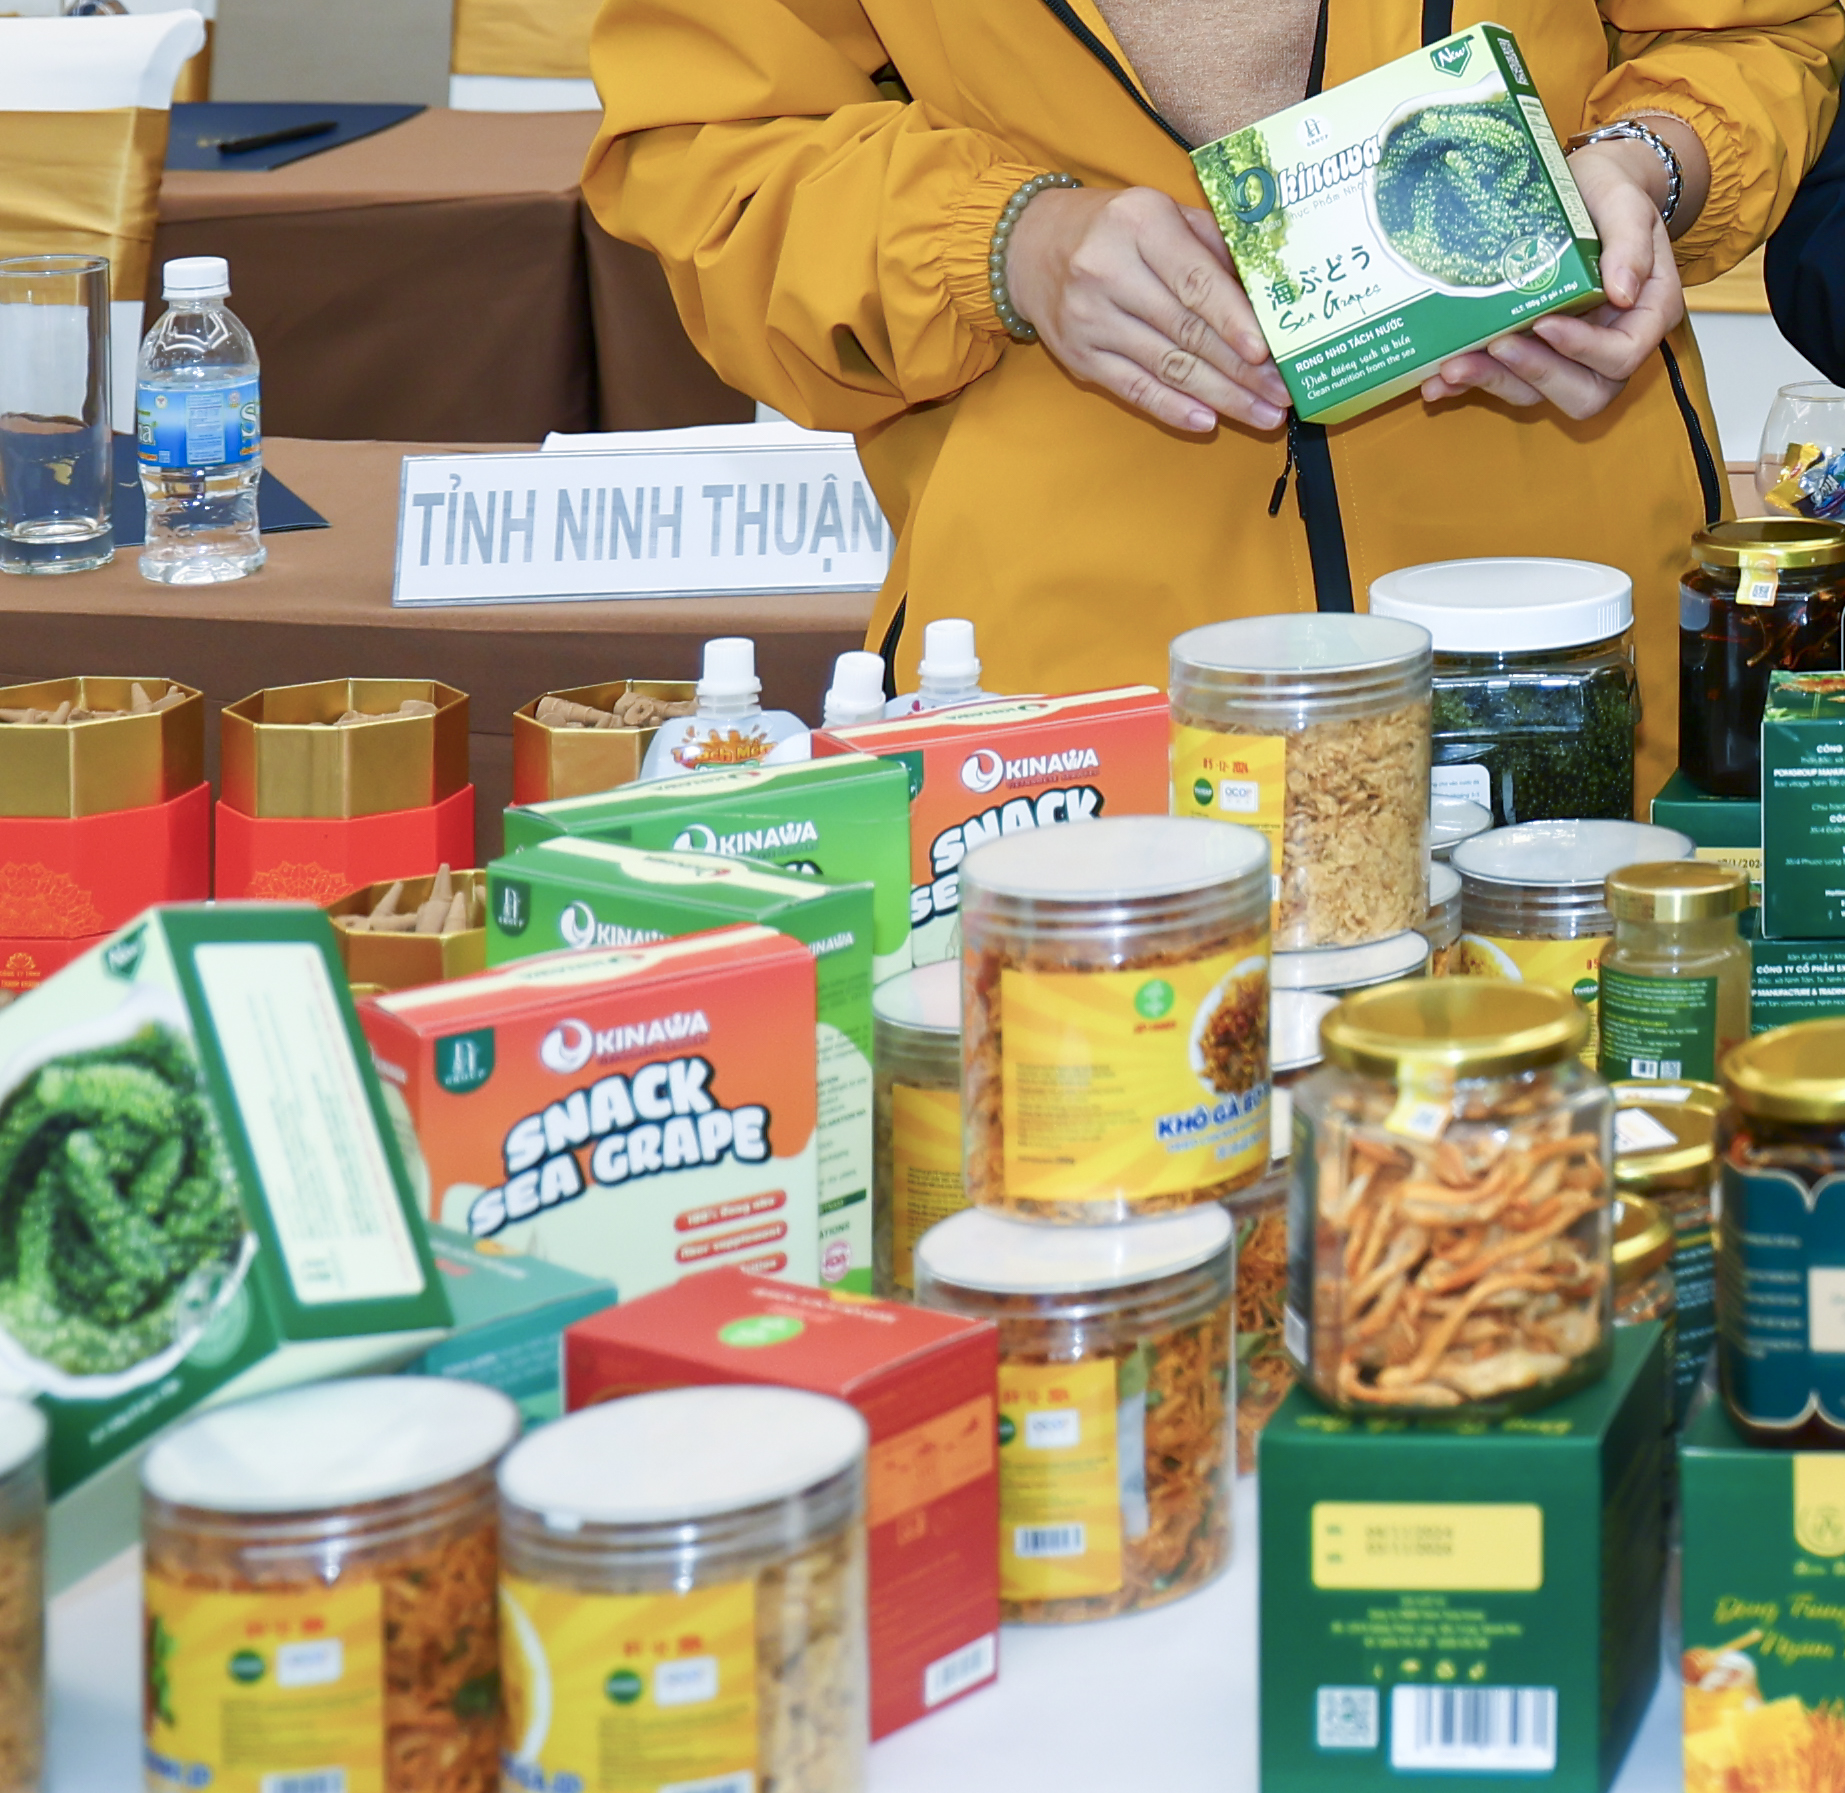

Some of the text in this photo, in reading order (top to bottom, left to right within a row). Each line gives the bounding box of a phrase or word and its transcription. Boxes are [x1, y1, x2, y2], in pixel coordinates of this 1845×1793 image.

[1233, 134, 1382, 223] Okinawa
[1265, 245, 1370, 310] 海ぶどう
[1279, 284, 1381, 336] Sea Grapes
[1295, 317, 1404, 373] RONG NHO TÁCH NƯỚC
[1307, 348, 1416, 400] Clean nutrition from the sea
[412, 473, 884, 573] TỈNH NINH THUẬN
[961, 748, 1100, 794] OKINAWA
[1816, 743, 1843, 754] CÔNG
[932, 786, 1098, 874] SNACK
[1756, 965, 1783, 974] CÔNG
[1784, 965, 1794, 974] TY
[540, 1009, 711, 1074] OKINAWA
[506, 1060, 712, 1170] SNACK
[1156, 1111, 1210, 1141] KHÔ
[470, 1110, 769, 1234] SEA GRAPE
